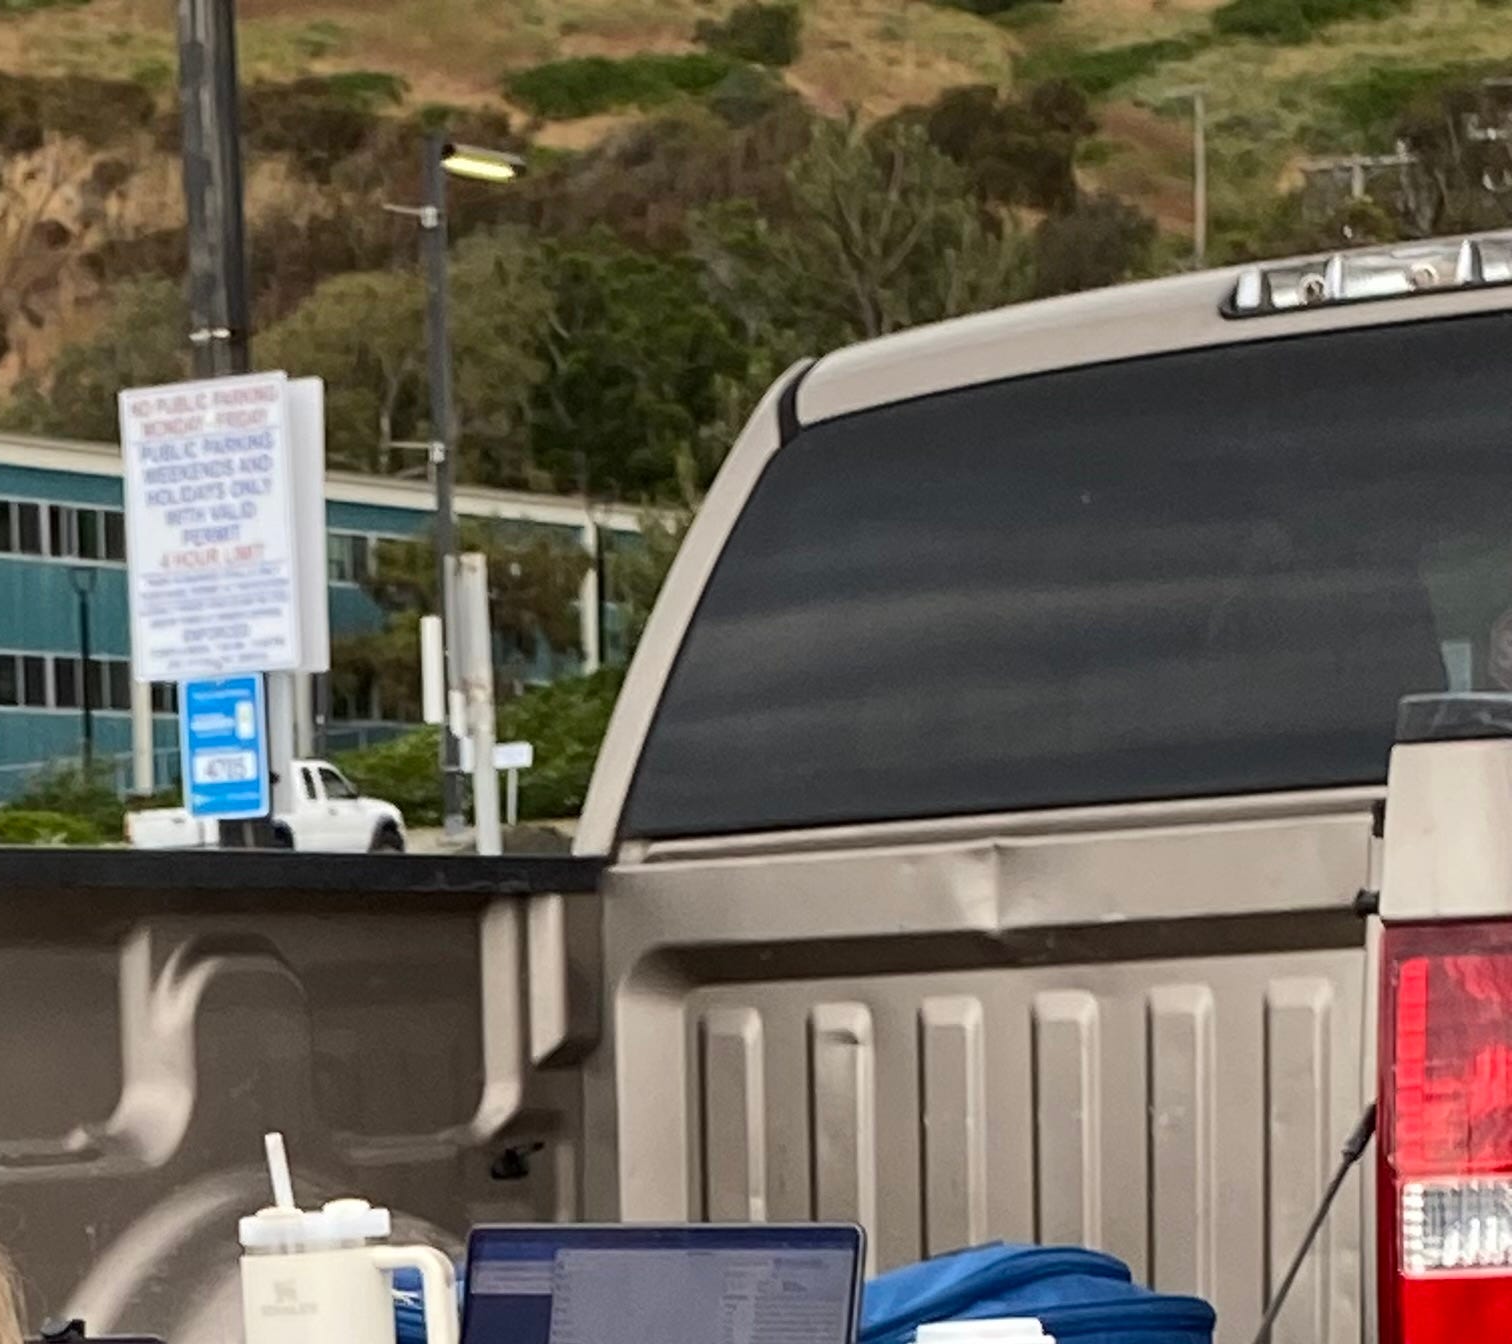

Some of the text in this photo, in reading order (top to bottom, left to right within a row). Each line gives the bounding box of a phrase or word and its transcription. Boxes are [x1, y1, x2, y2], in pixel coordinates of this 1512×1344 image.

[133, 385, 276, 416] NO PUBLIC PARKING
[144, 408, 267, 436] MONDAY FRIDAY
[142, 432, 273, 461] PUBLIC PARKING
[145, 455, 273, 483] WEEKENDS AND
[146, 477, 271, 505] HOLIDAYS ONLY
[166, 501, 255, 524] WITH VALID
[183, 524, 239, 545] PERMIT
[172, 549, 217, 566] HOUR
